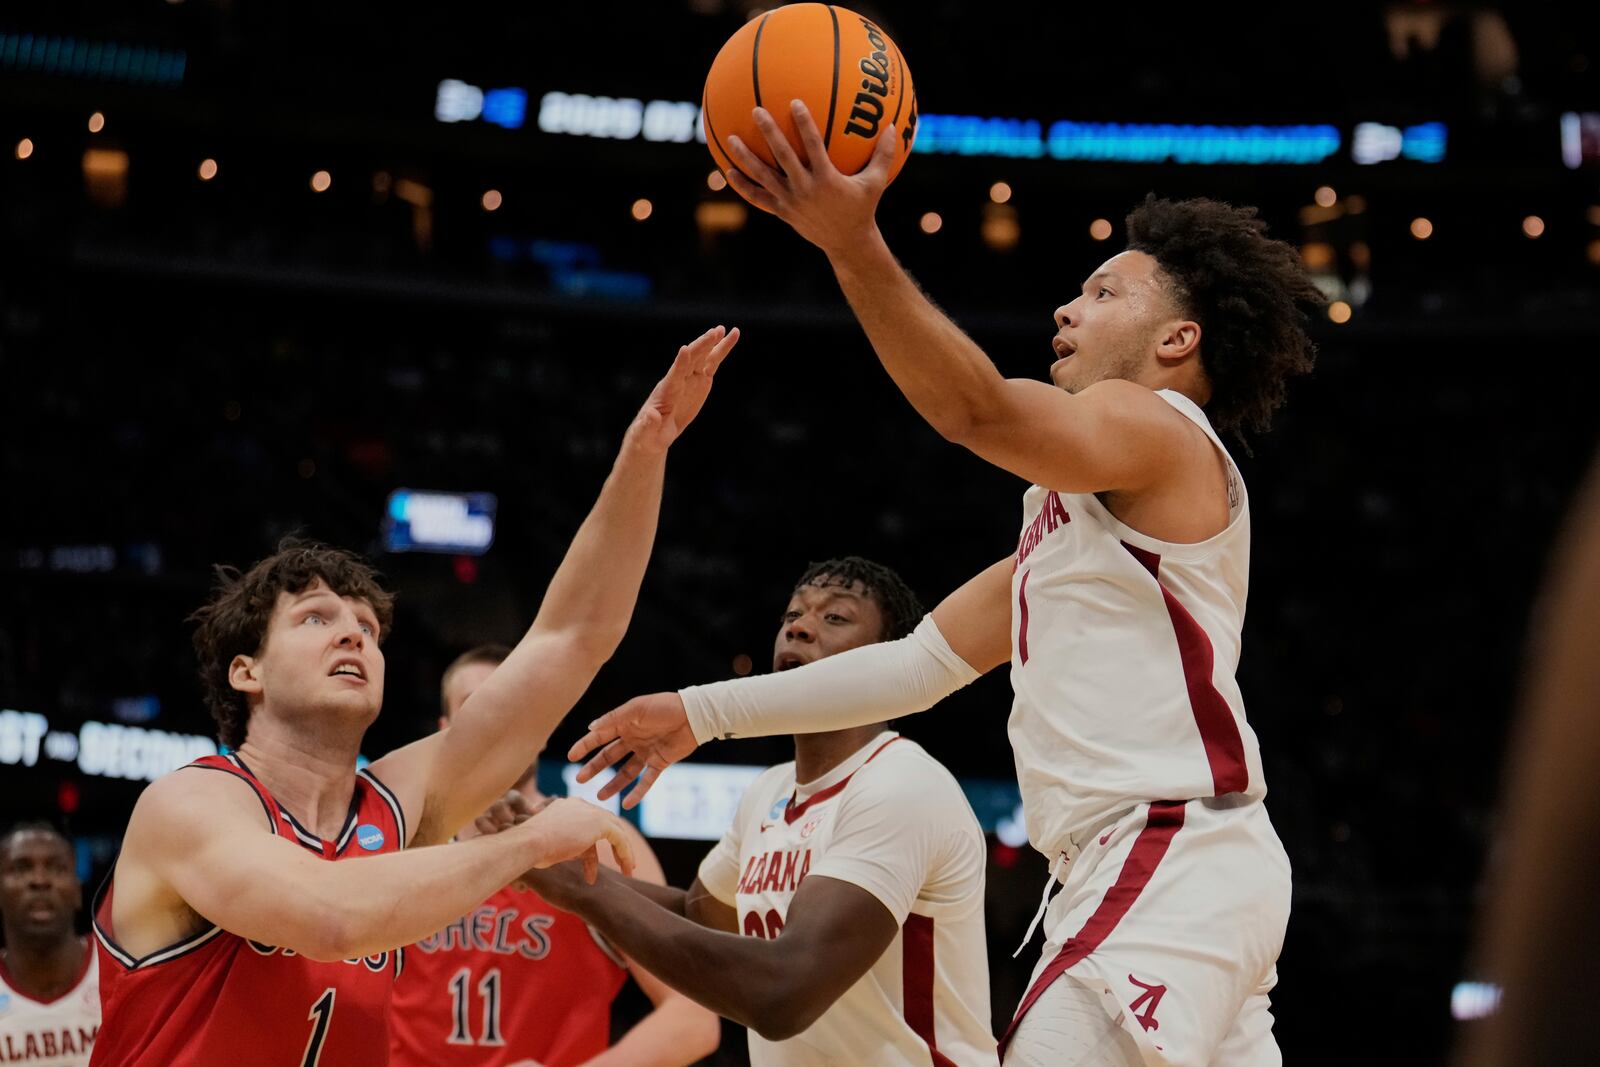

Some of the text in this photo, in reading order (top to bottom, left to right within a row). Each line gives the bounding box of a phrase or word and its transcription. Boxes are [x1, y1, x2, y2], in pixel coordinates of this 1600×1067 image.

[843, 17, 890, 139] Wilson
[0, 1025, 98, 1062] LABAM
[300, 986, 337, 1067] 1
[447, 966, 506, 1047] 11
